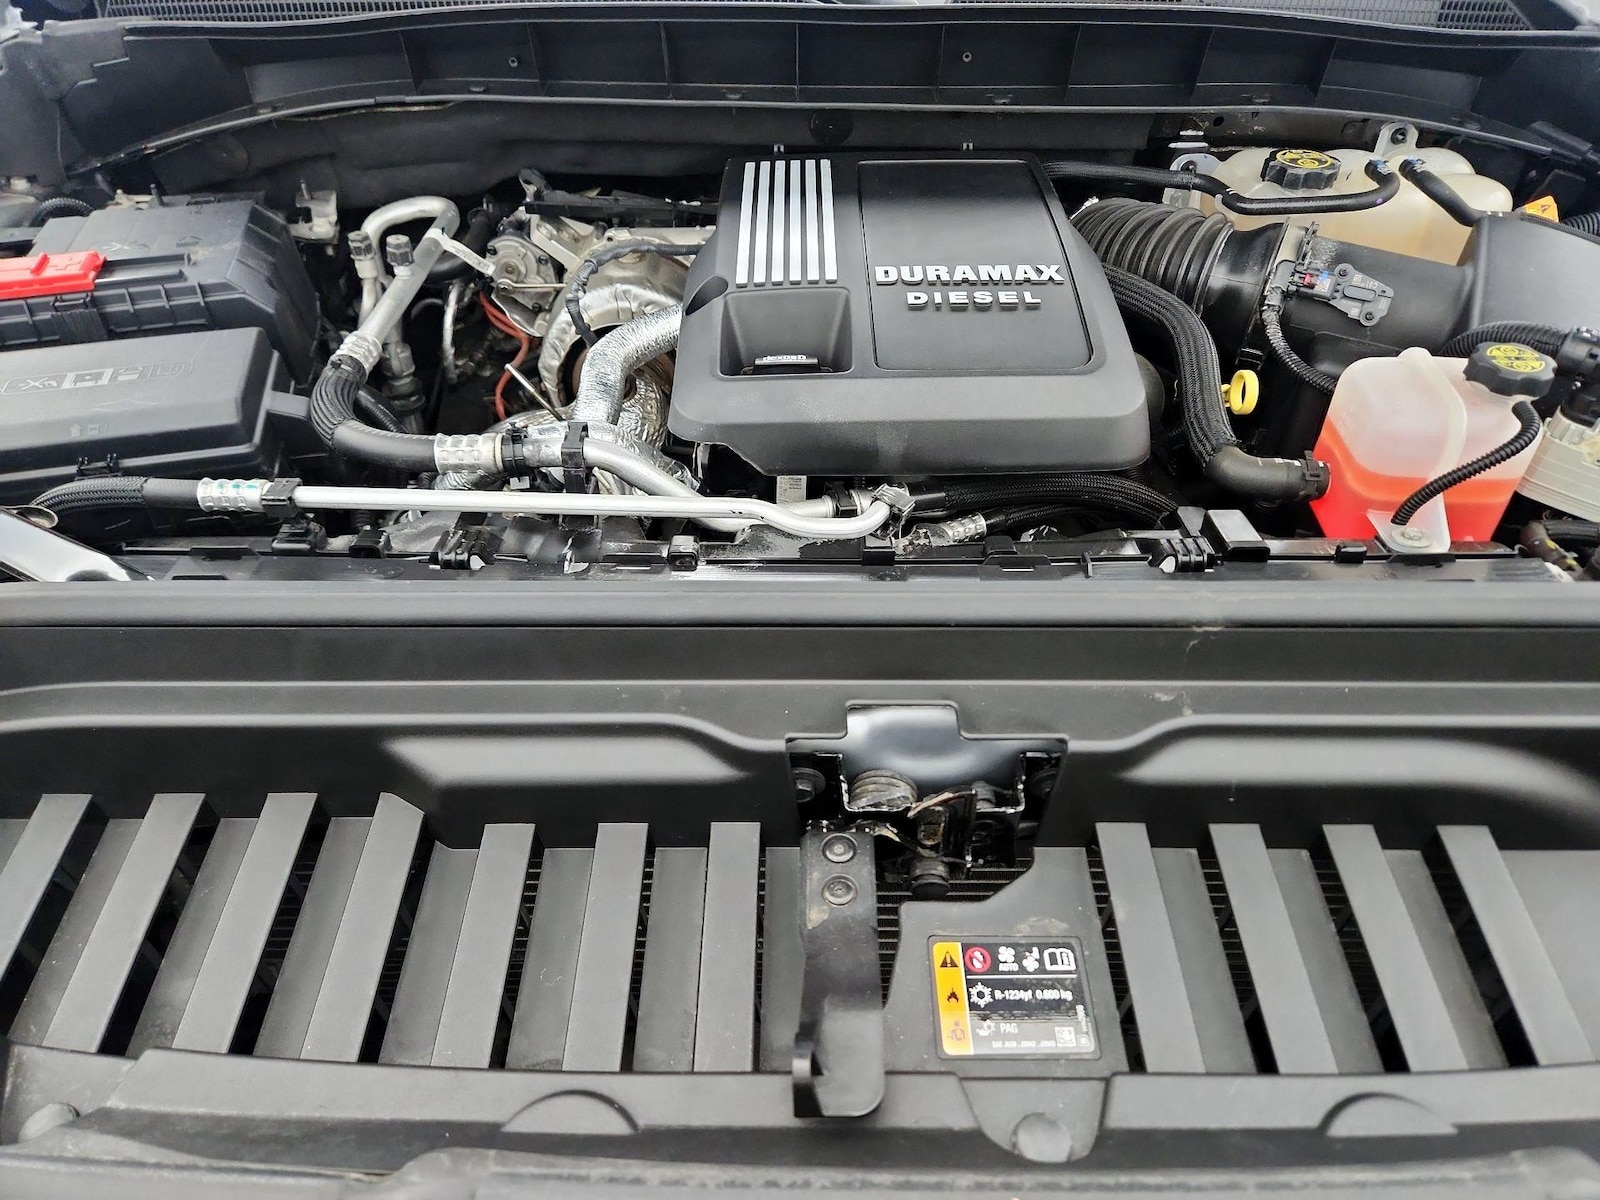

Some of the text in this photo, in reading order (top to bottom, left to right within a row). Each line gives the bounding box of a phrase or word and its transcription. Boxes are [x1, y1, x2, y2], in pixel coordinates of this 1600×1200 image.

[874, 264, 1065, 285] DURAMAX
[906, 291, 1042, 308] DIESEL
[999, 962, 1019, 972] AUTO
[1000, 1022, 1019, 1034] PAG
